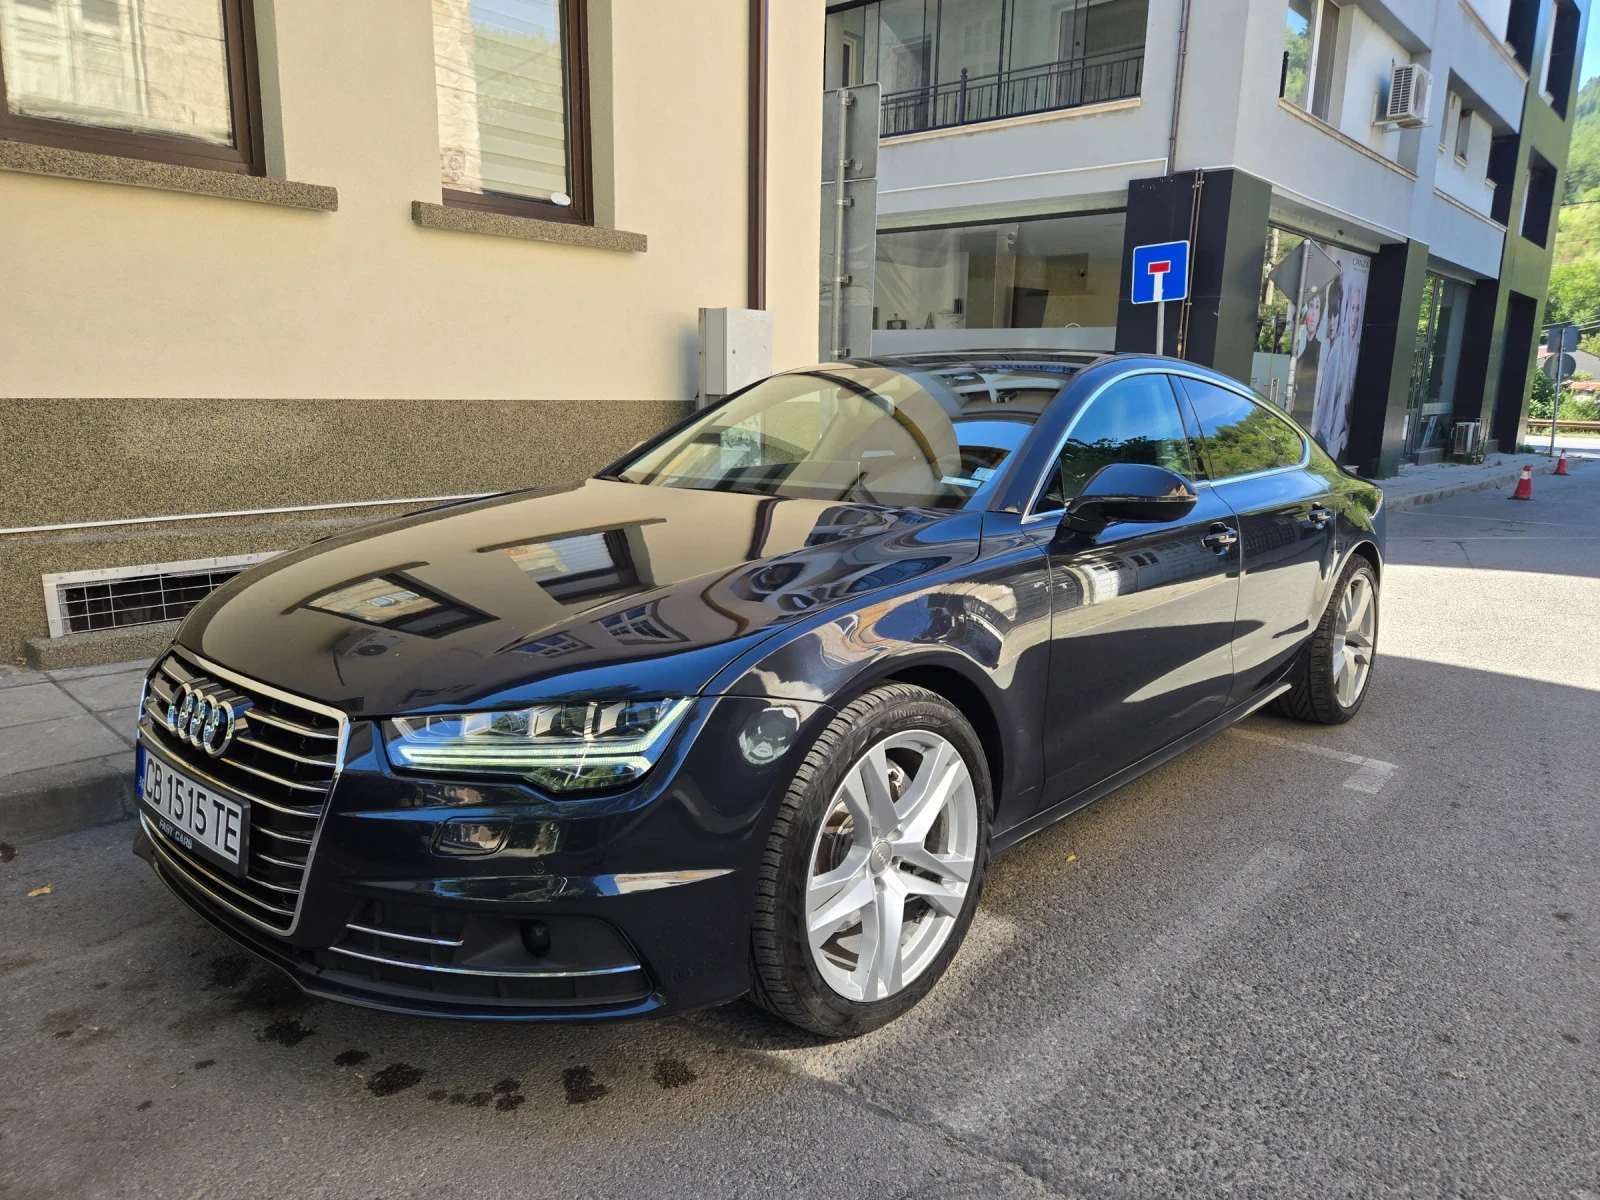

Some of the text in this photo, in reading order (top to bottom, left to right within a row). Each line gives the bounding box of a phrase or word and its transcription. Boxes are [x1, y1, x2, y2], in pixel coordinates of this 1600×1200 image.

[168, 774, 207, 835] 1515
[213, 799, 239, 857] TE
[174, 831, 193, 850] CARS
